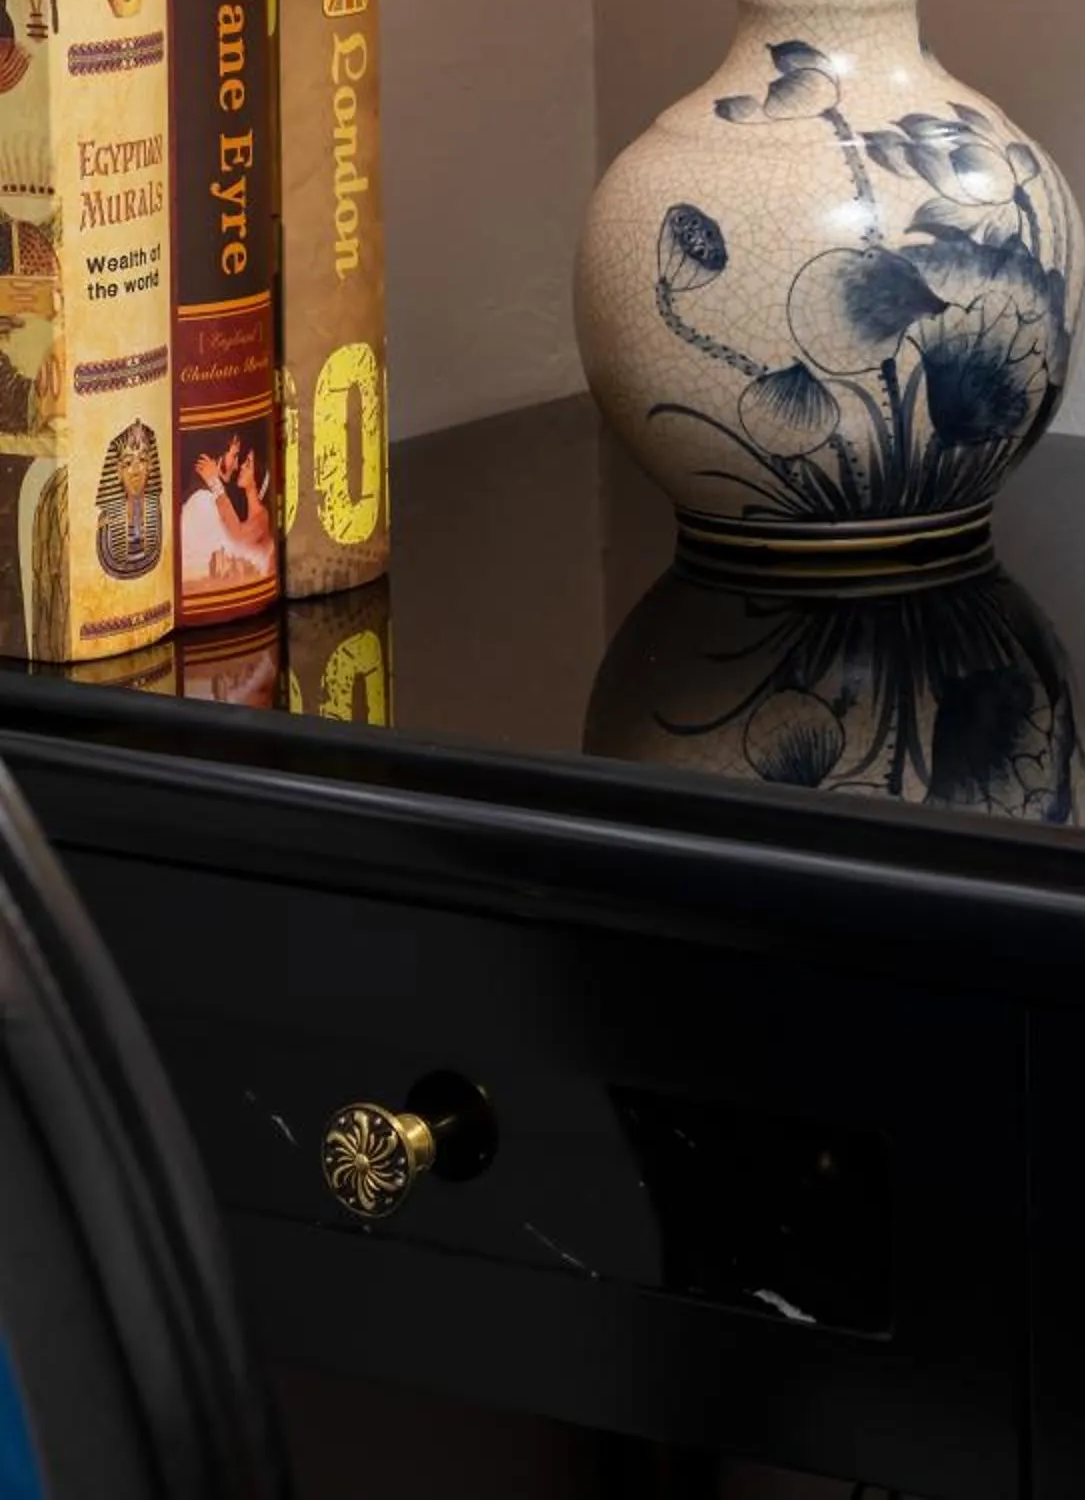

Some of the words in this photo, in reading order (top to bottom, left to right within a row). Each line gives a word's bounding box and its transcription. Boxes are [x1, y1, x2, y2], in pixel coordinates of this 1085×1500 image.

[331, 32, 369, 280] London
[210, 128, 253, 276] Eyre
[86, 247, 147, 275] Wealth
[149, 243, 161, 262] of
[86, 282, 120, 301] the
[123, 268, 160, 294] world
